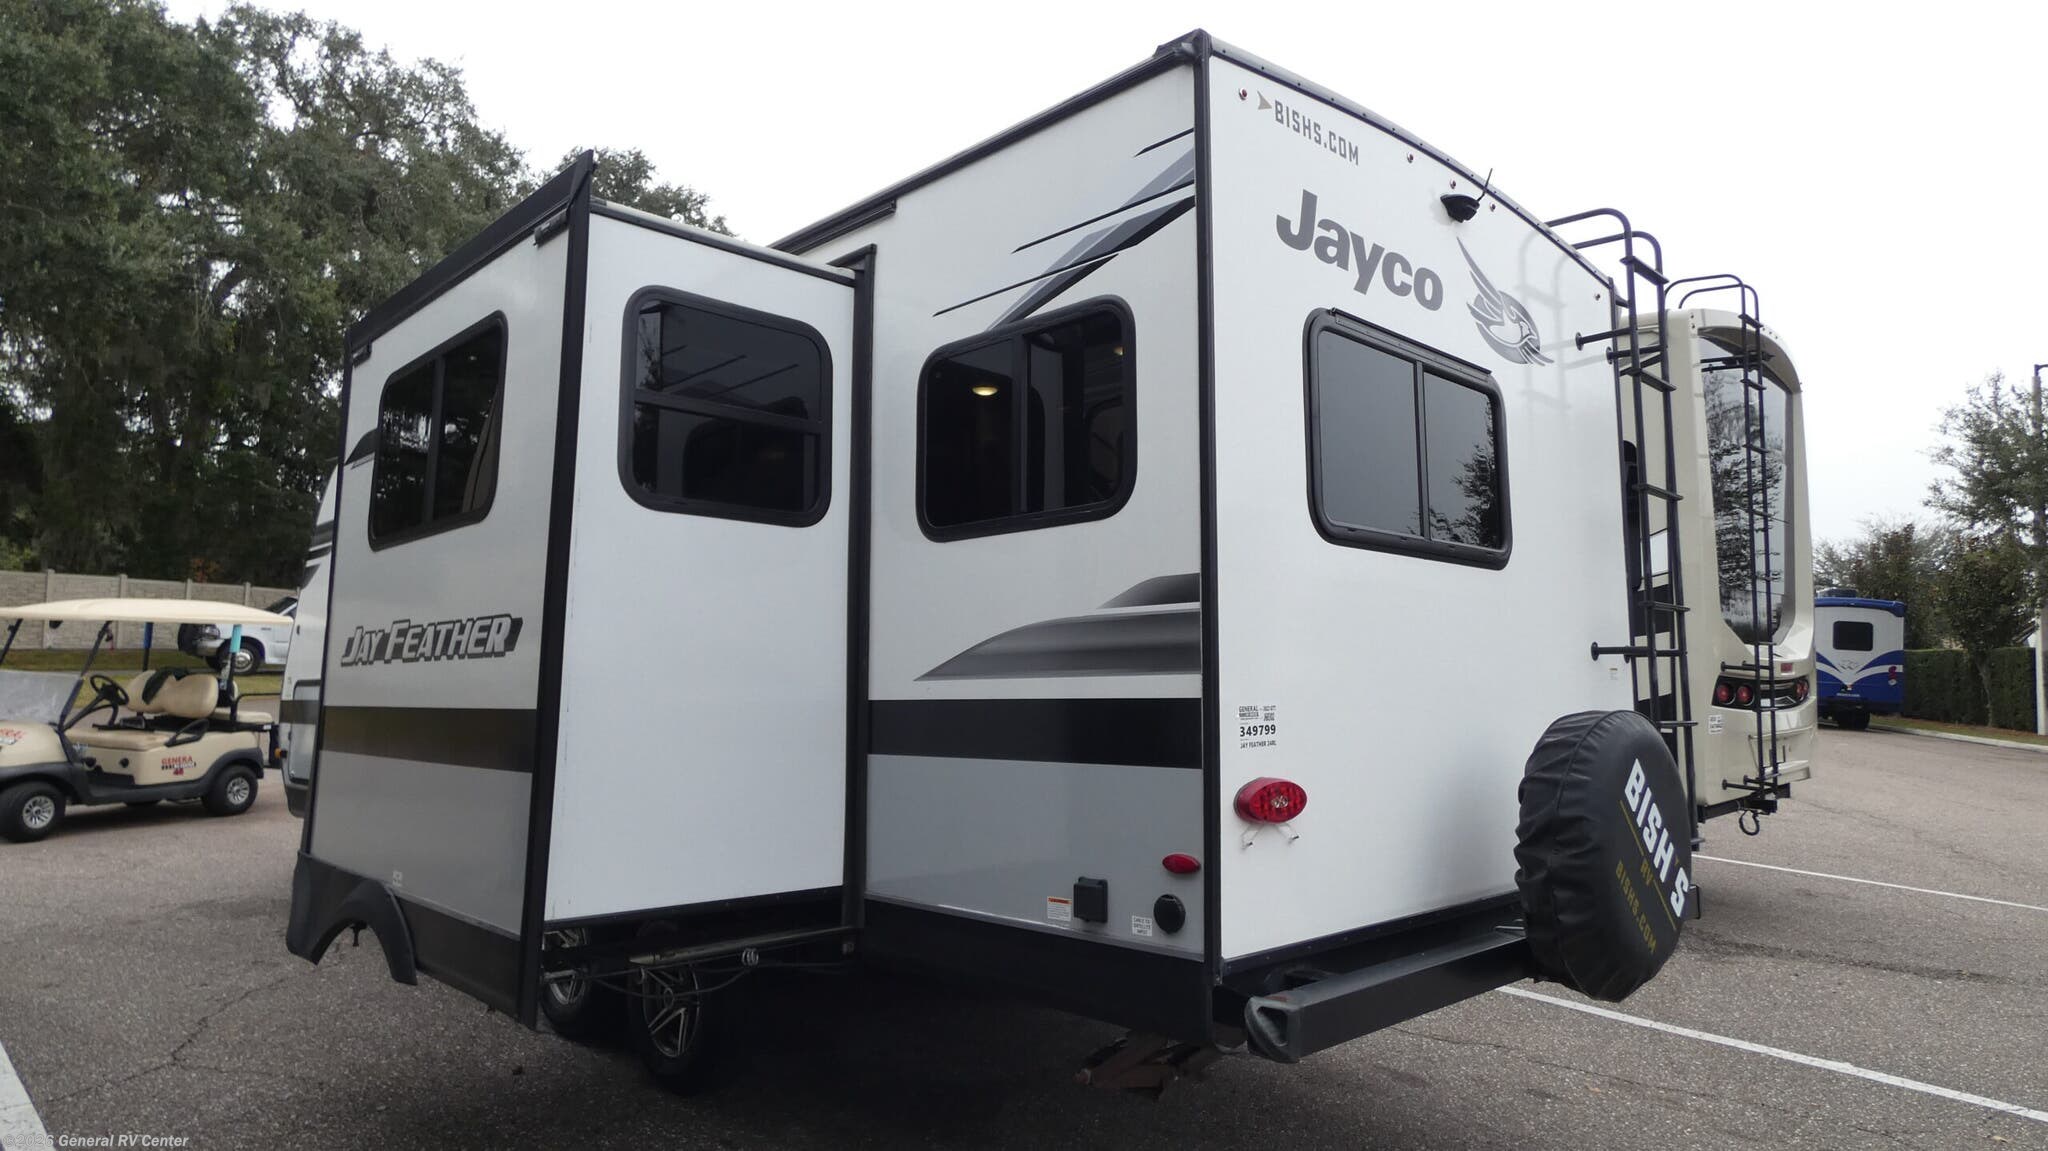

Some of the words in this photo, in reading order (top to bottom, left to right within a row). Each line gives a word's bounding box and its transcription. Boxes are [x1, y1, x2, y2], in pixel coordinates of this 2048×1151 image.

[1274, 99, 1360, 166] BISHS.COM
[1275, 189, 1444, 311] Jayco
[341, 626, 385, 667] JAY
[384, 613, 523, 664] FEATHER
[1239, 724, 1276, 737] 349799
[1615, 859, 1657, 954] BISHS.COM
